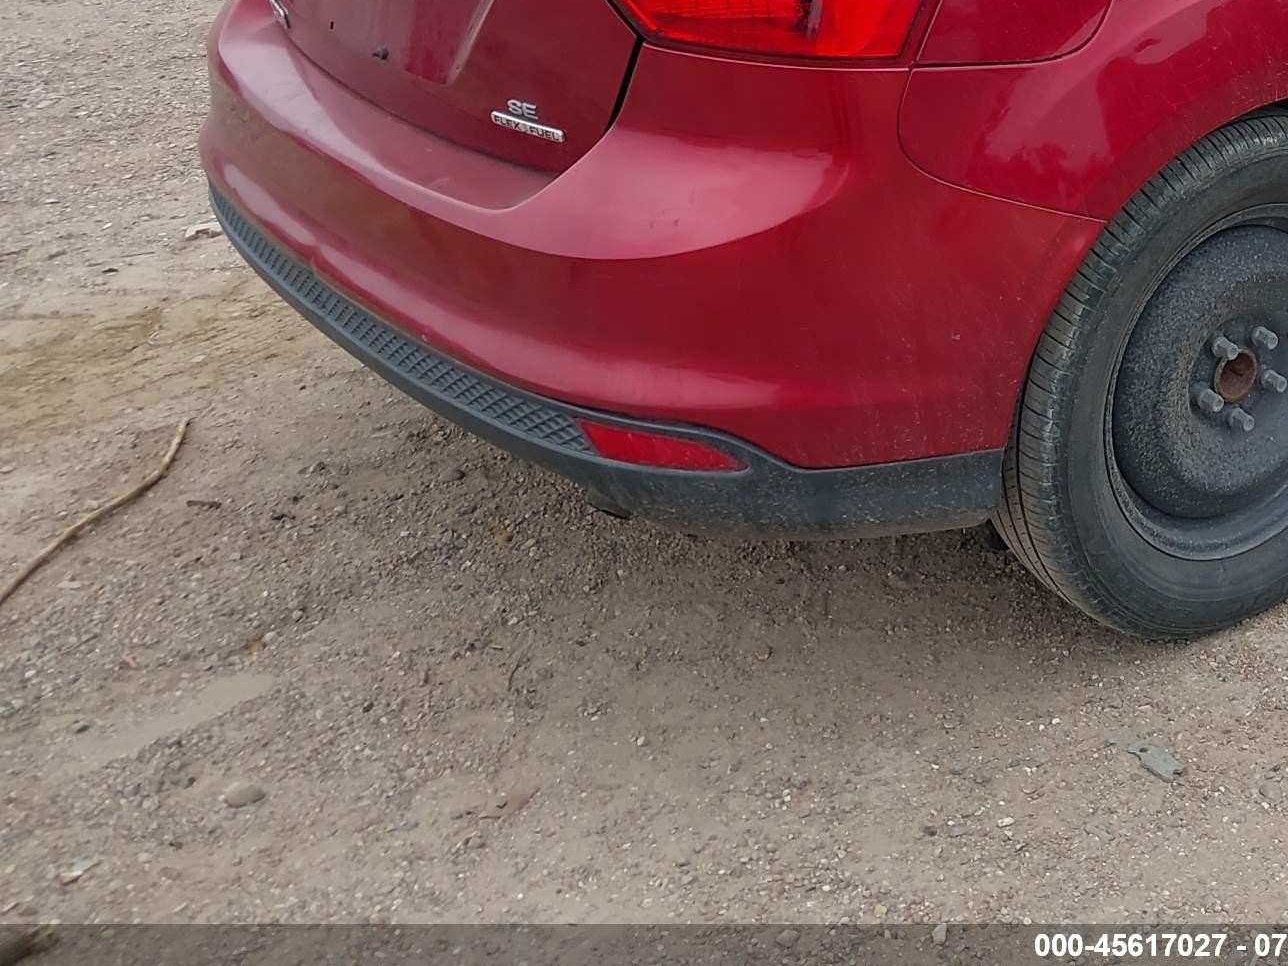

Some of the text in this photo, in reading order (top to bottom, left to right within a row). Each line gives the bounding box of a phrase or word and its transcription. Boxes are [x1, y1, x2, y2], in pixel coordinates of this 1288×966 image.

[507, 99, 538, 120] SE
[494, 114, 560, 141] FLEX FUEL
